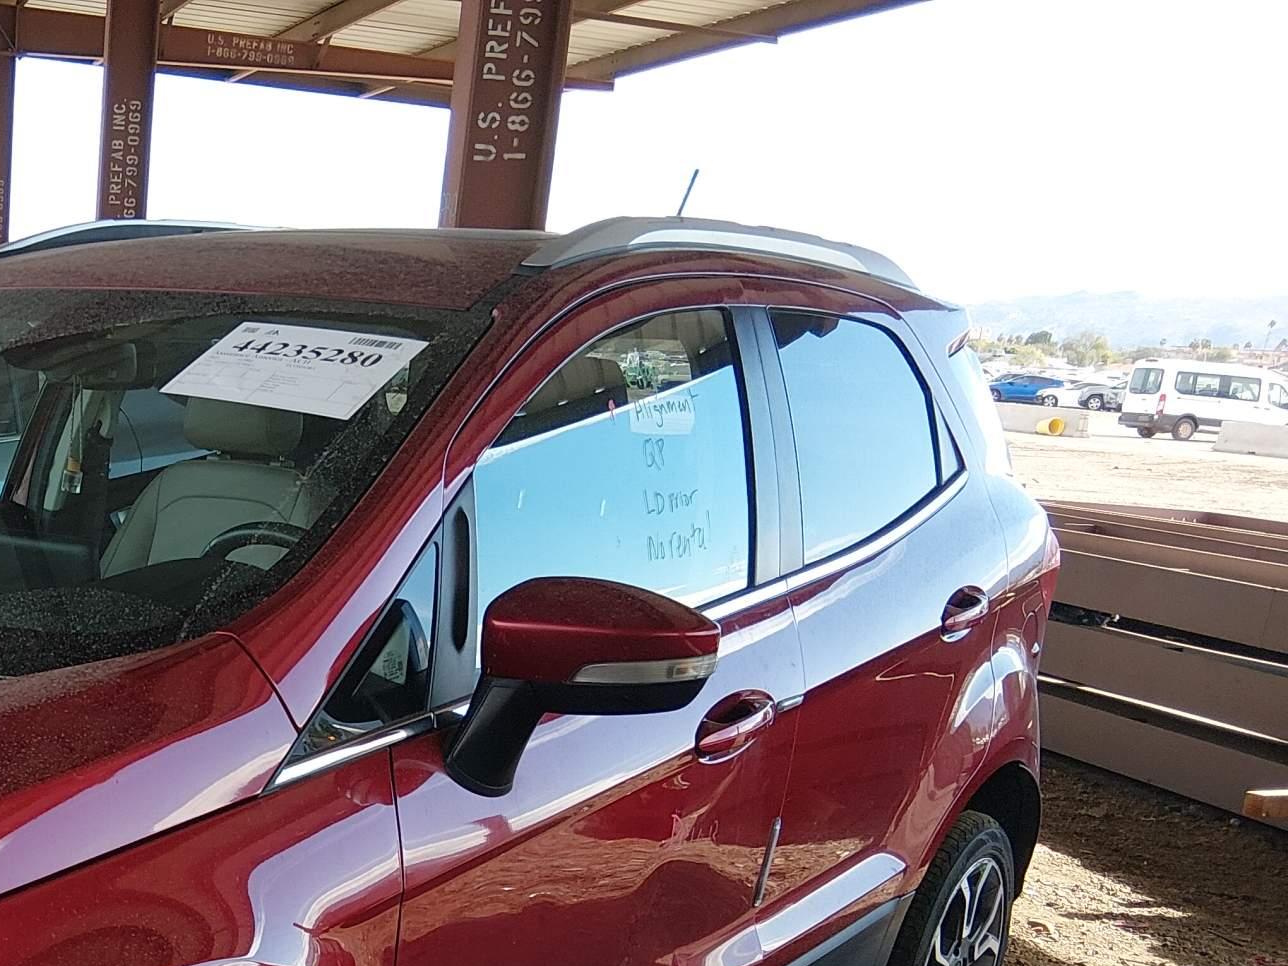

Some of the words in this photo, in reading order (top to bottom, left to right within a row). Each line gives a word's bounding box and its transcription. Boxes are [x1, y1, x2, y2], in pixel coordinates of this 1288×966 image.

[232, 36, 273, 52] PREFAB
[482, 0, 513, 81] PREF
[503, 0, 542, 160] 1-866-79
[113, 98, 127, 130] INC.
[472, 101, 503, 161] U.S.
[108, 139, 124, 205] PREFAB
[123, 100, 142, 219] 66-799-0969
[232, 339, 384, 369] 44235280
